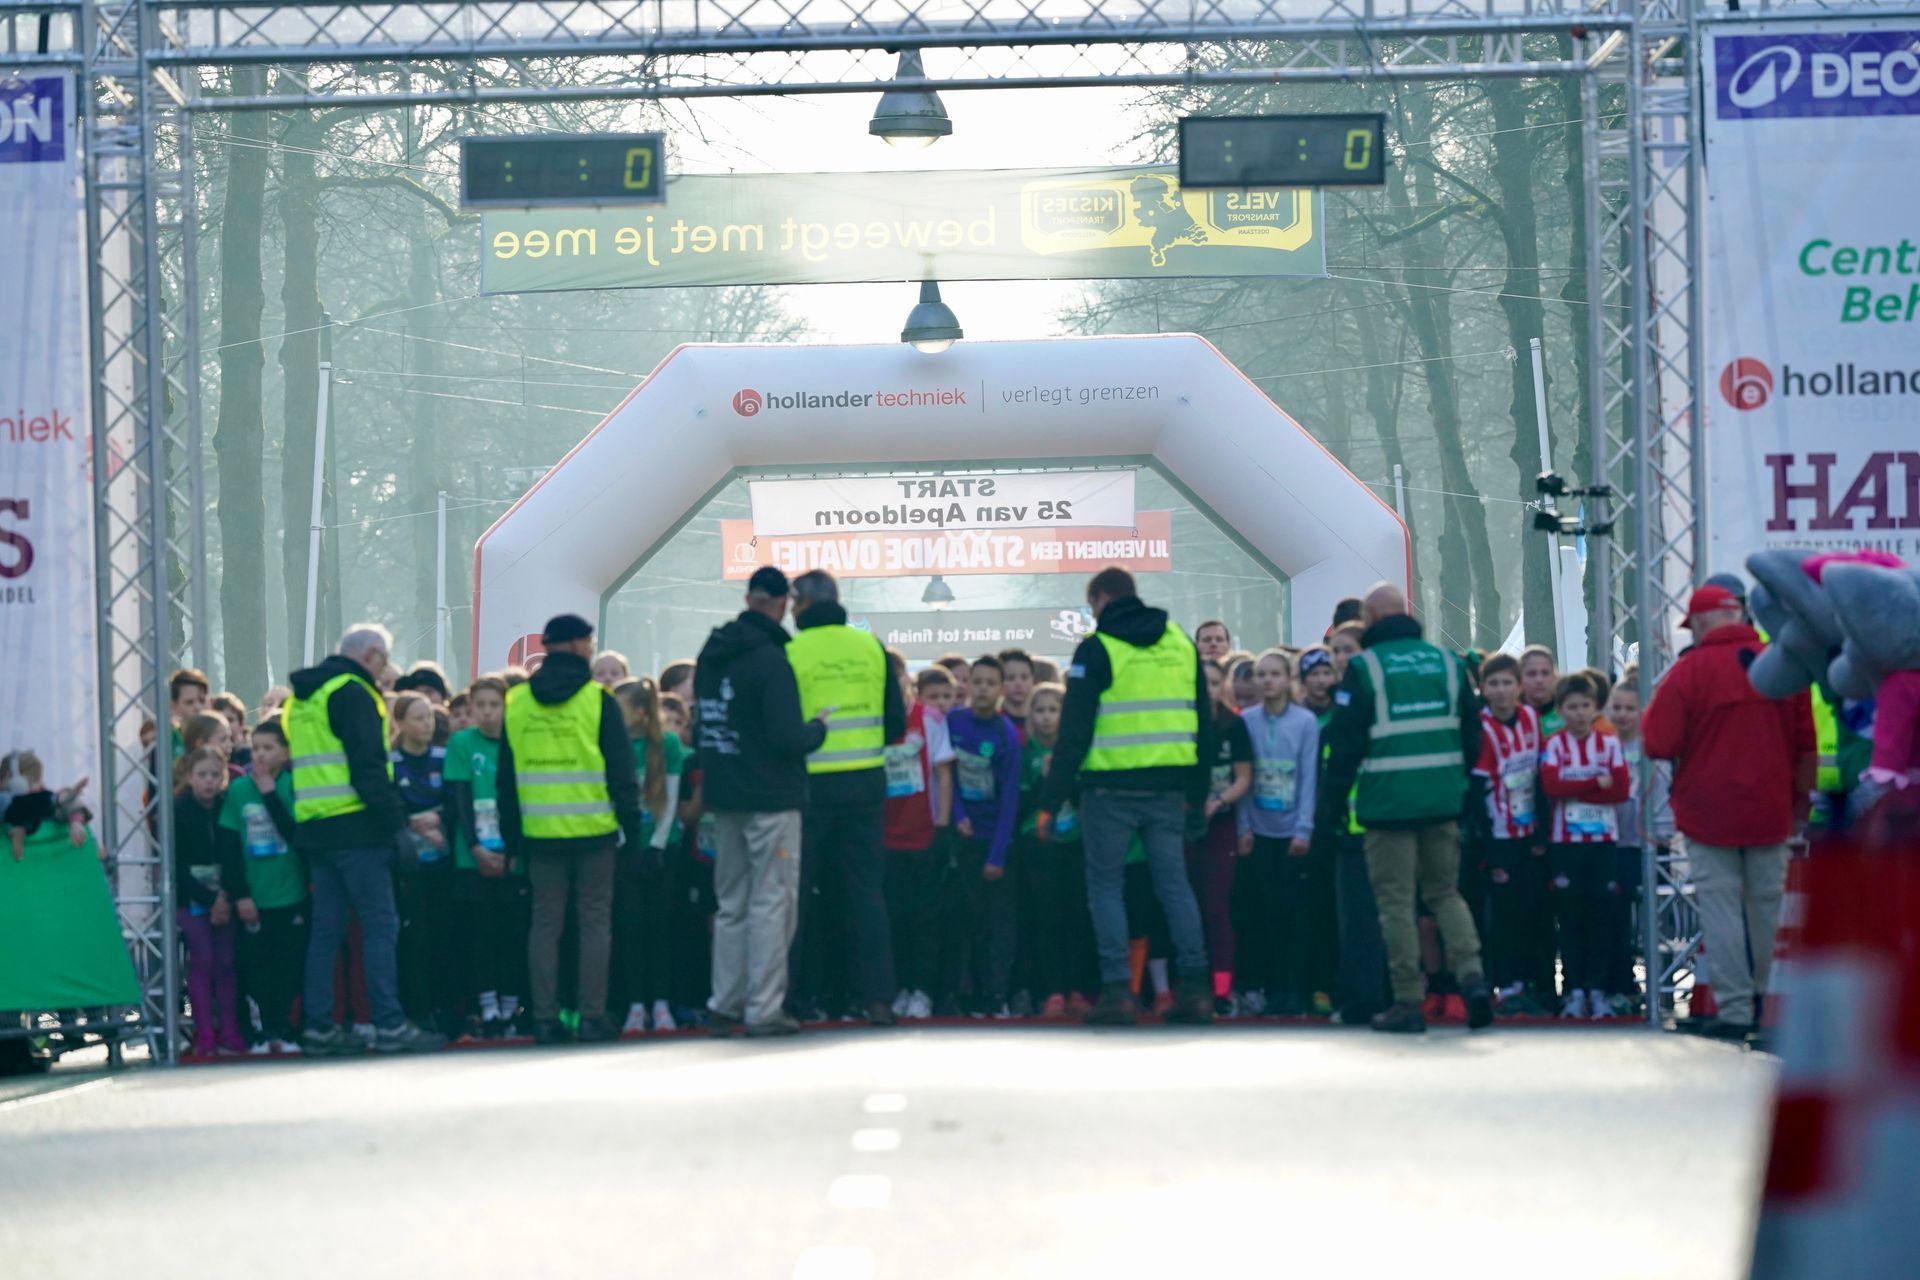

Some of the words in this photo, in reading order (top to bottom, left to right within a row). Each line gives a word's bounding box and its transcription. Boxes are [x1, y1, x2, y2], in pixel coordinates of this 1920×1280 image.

[1799, 238, 1920, 276] Cent
[767, 391, 872, 409] hollander
[876, 388, 967, 407] techniek
[1002, 386, 1072, 406] verlegt
[1079, 384, 1160, 405] grenzen
